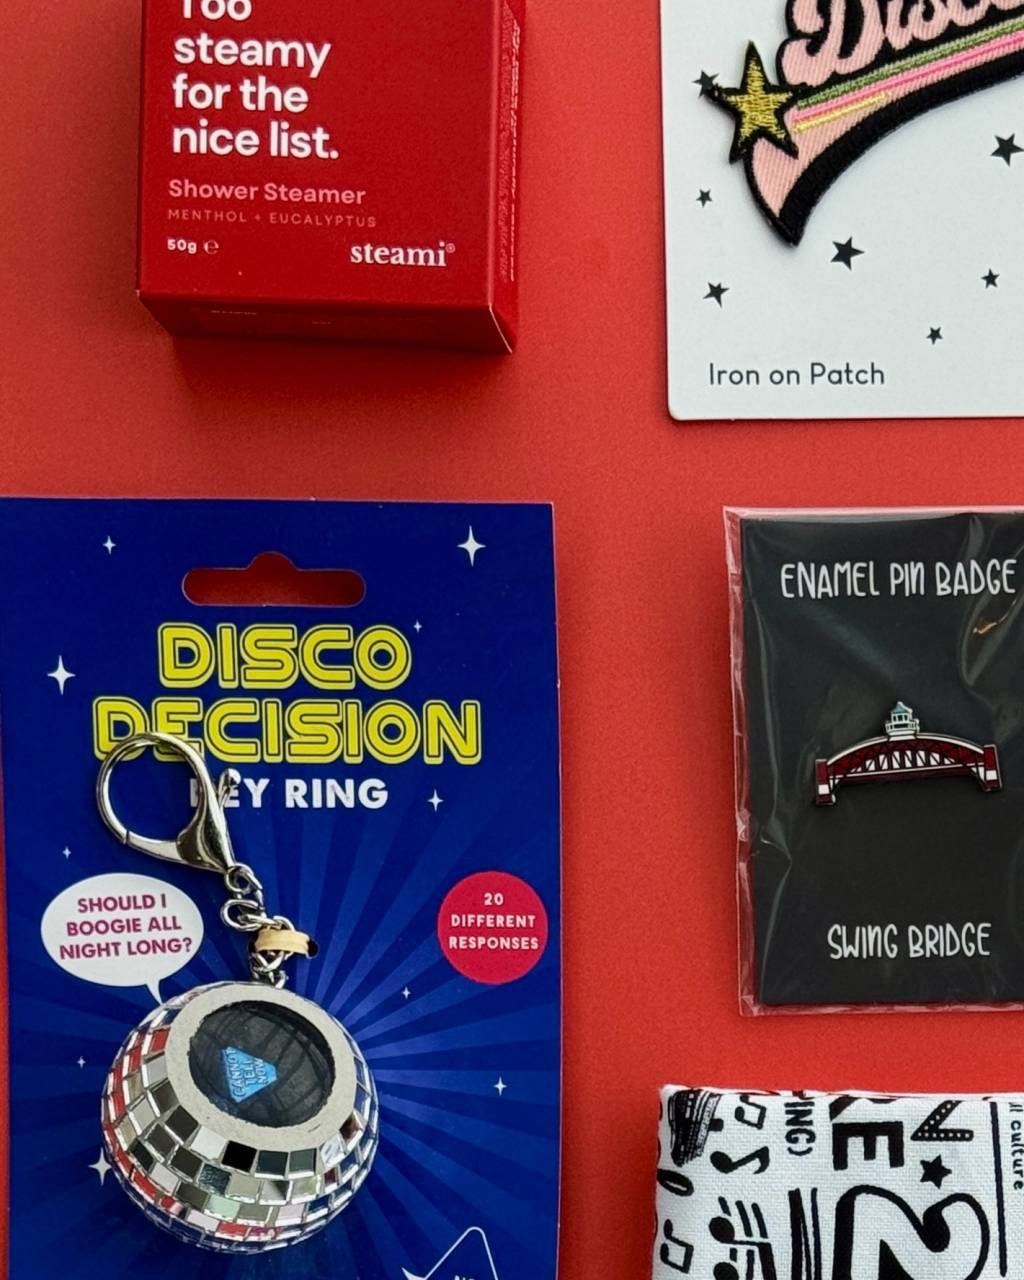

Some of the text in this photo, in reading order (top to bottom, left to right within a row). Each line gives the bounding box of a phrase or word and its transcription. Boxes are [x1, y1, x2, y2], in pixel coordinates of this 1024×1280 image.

[174, 32, 332, 78] steamy
[173, 73, 309, 113] for the
[173, 118, 339, 160] nice list.
[167, 179, 367, 205] Shower Steamer
[168, 209, 248, 224] MENTHOL
[269, 212, 378, 228] EUCALYPTUS
[167, 239, 197, 254] 50g
[709, 362, 885, 385] Iron on Patch
[780, 561, 880, 599] ENAMEL
[936, 559, 1017, 595] BADGE
[157, 622, 412, 690] DISCO
[93, 695, 483, 764] DECISION
[285, 778, 389, 809] RING
[76, 893, 167, 913] SHOULD I
[484, 892, 504, 906] 20
[66, 914, 182, 937] BOOGIE ALL
[450, 914, 536, 928] DIFFERENT
[59, 936, 192, 961] NIGHT LONG?
[448, 936, 540, 951] RESPONSES
[827, 923, 991, 960] SWING BRIDGE
